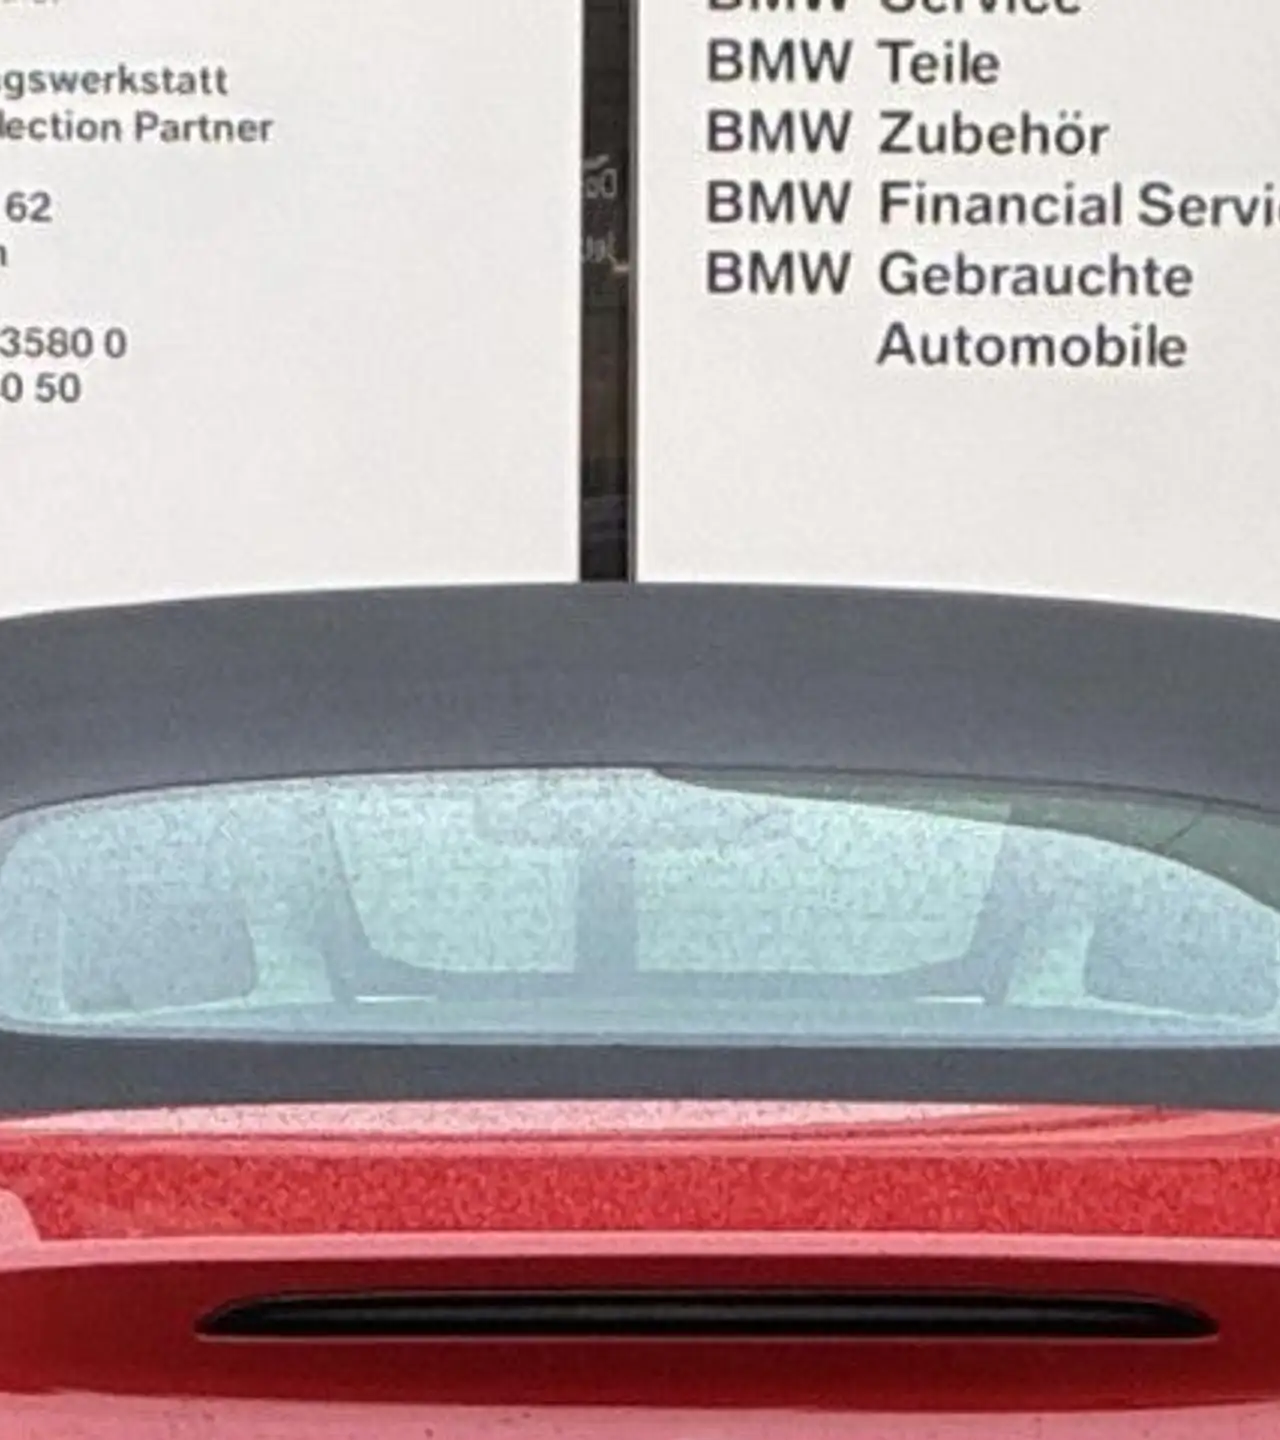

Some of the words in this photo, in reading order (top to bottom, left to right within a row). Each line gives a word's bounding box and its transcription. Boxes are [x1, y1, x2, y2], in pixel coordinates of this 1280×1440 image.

[707, 37, 854, 84] BMW
[875, 38, 1001, 86] Teile
[134, 110, 274, 143] Partner
[706, 108, 854, 155] BMW
[878, 108, 1111, 157] Zubehör
[4, 191, 52, 224] 62
[706, 178, 853, 225] BMW
[879, 179, 1123, 228] Financial
[706, 249, 853, 296] BMW
[878, 249, 1194, 299] Gebrauchte
[103, 327, 128, 360] 0
[875, 320, 1188, 369] Automobile
[35, 371, 82, 404] 50
